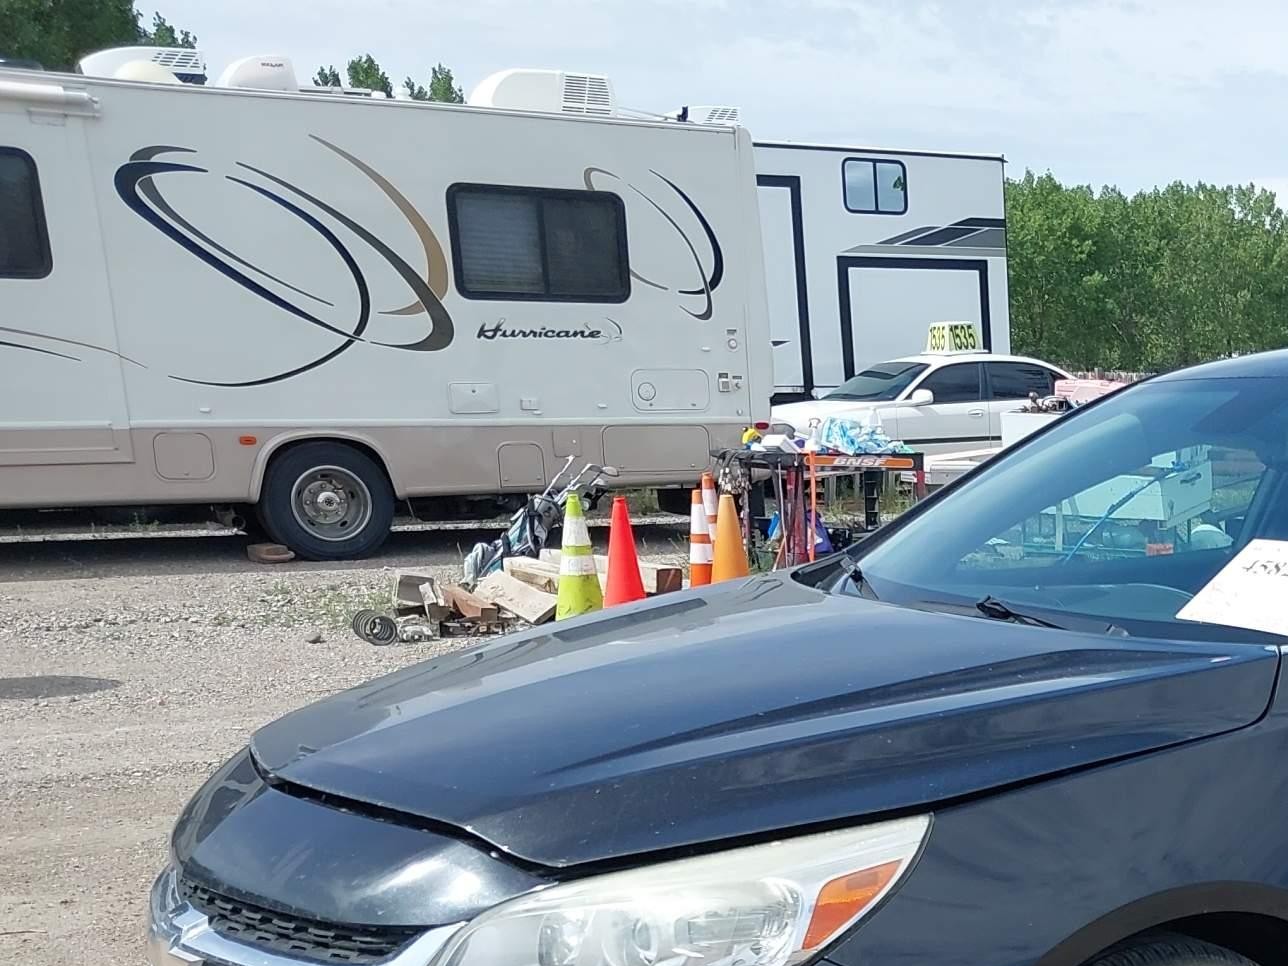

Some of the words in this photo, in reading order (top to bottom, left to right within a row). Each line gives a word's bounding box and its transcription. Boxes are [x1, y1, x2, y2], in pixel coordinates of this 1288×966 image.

[477, 318, 601, 340] Hurricane
[929, 325, 946, 351] 1535
[949, 324, 977, 351] 1535
